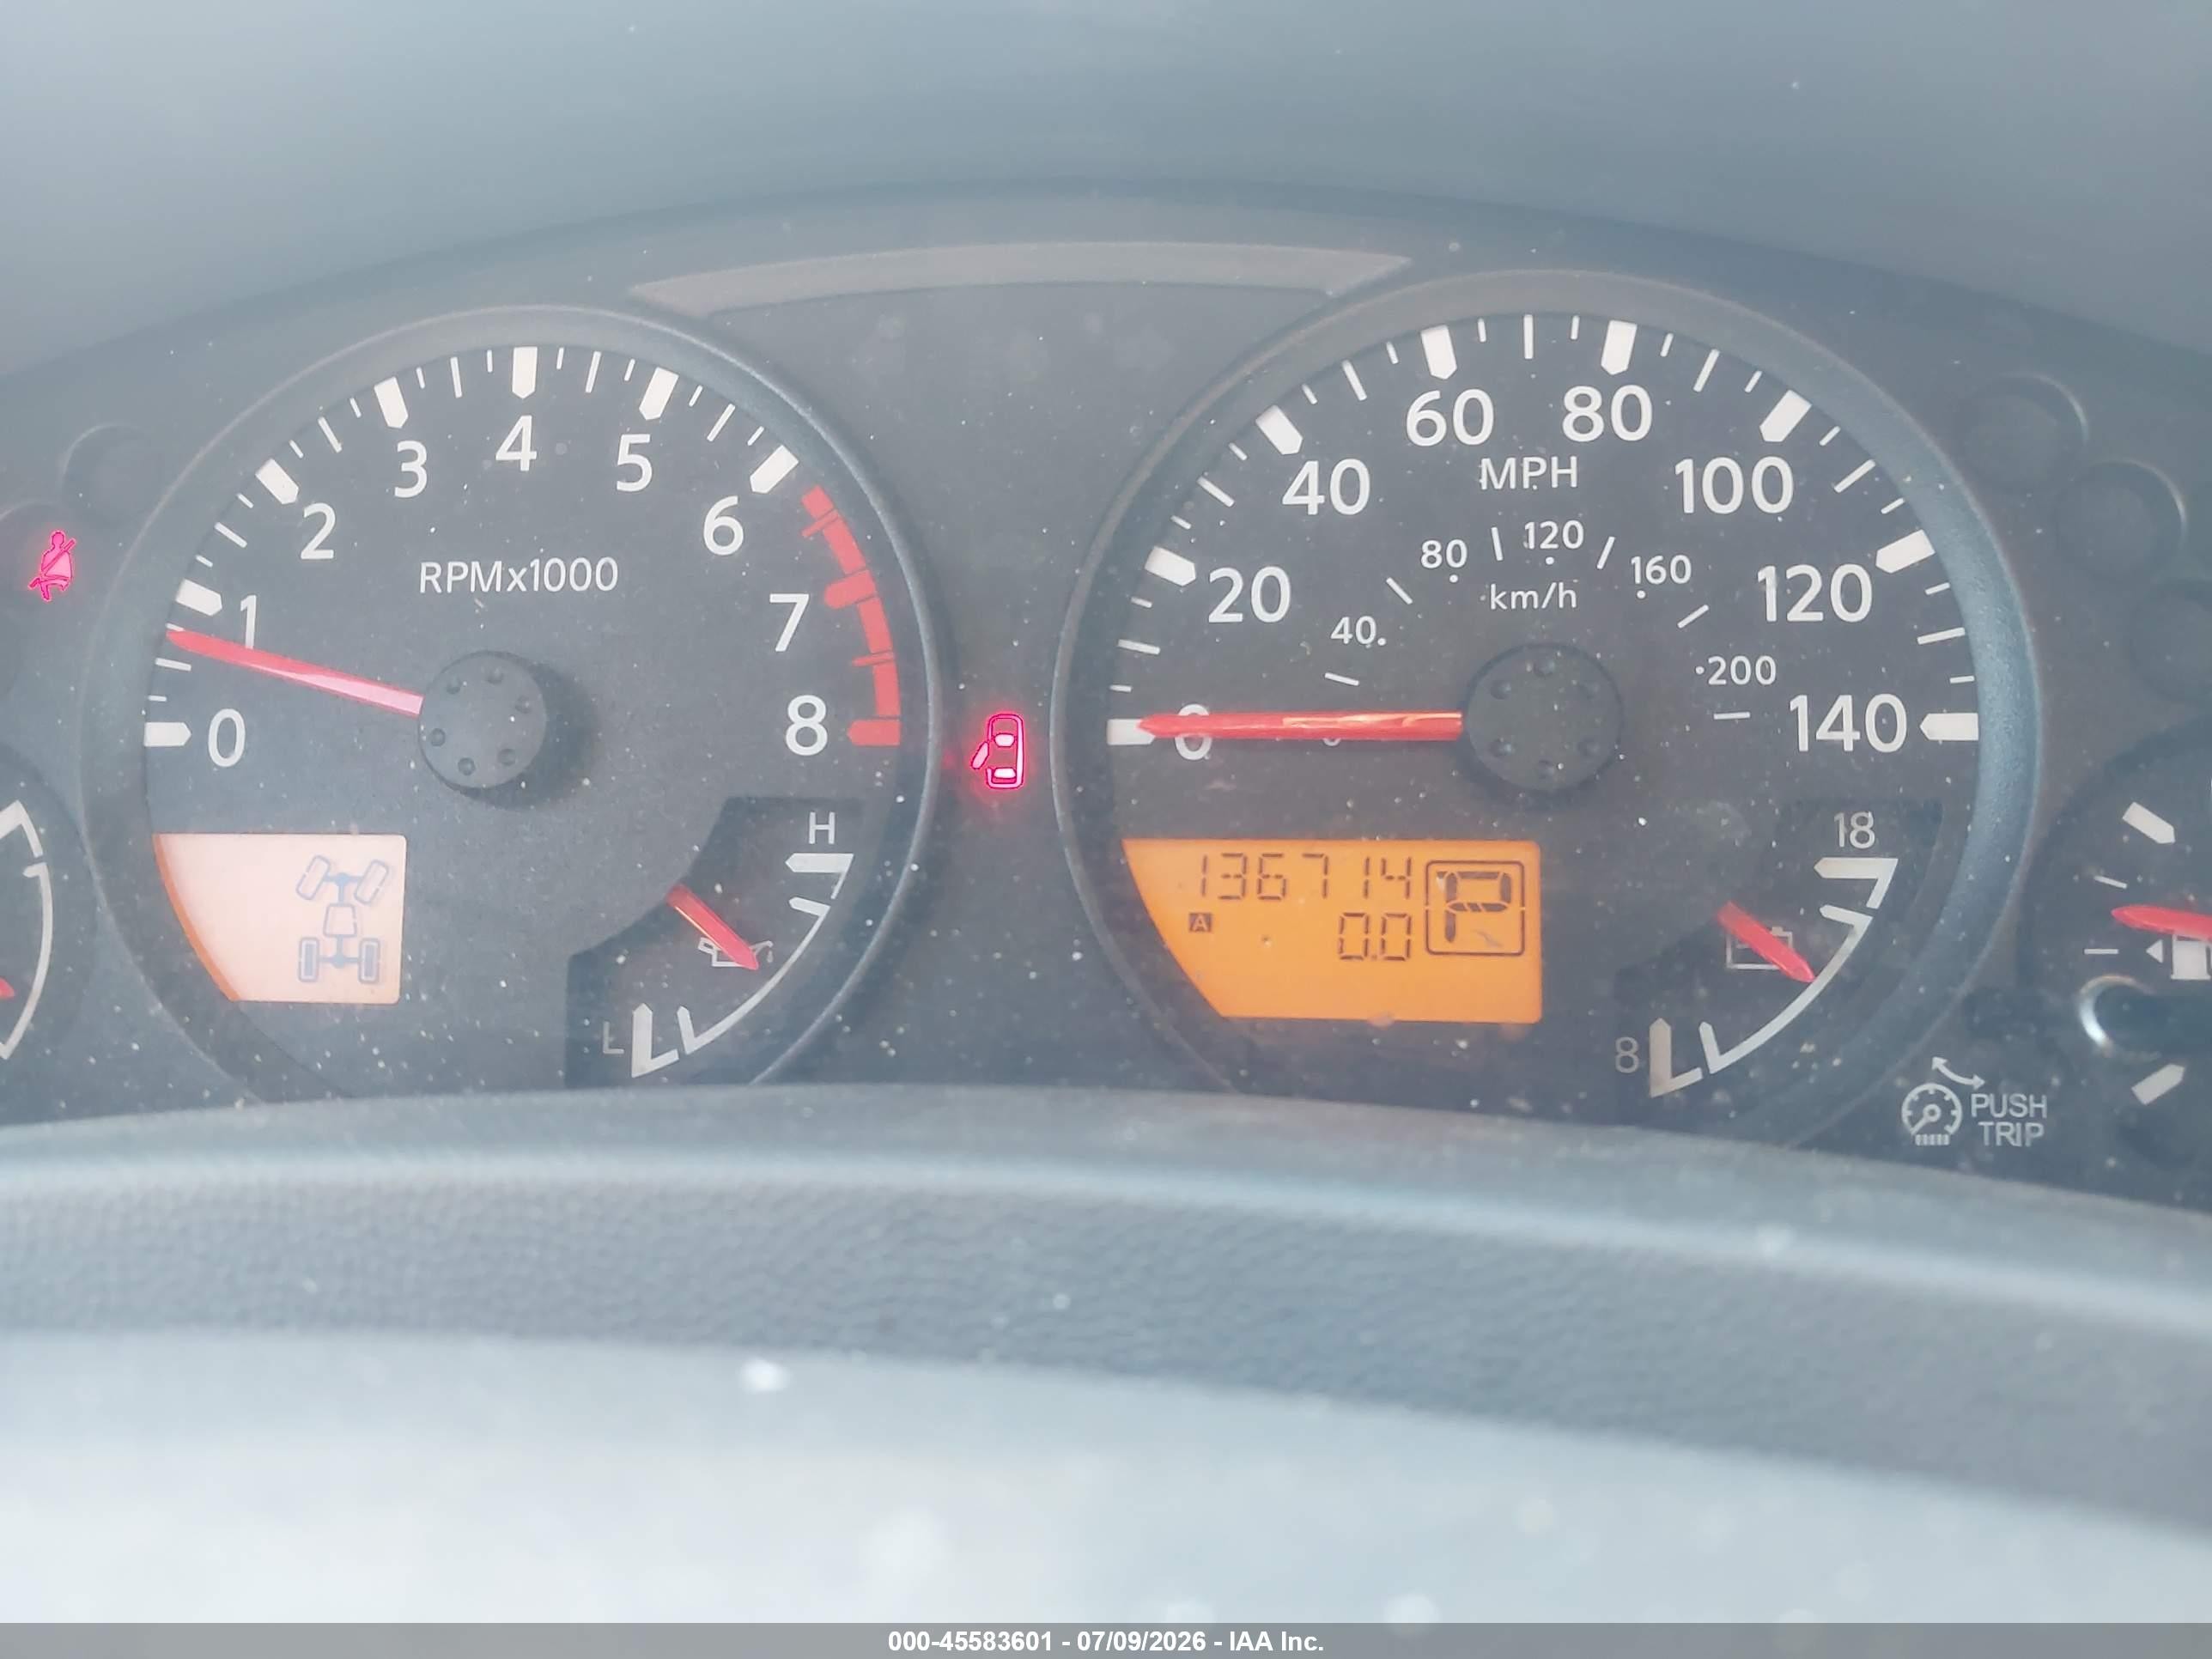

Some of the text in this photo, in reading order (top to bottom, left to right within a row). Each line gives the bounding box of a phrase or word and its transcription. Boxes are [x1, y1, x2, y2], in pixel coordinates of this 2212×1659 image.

[1406, 388, 1494, 447] 60
[1561, 384, 1653, 442] 80
[394, 441, 428, 498] 3
[495, 415, 537, 471] 4
[617, 434, 653, 492] 5
[1282, 458, 1371, 515] 40
[1480, 456, 1578, 490] MPH
[1674, 456, 1794, 514] 100
[300, 503, 337, 560] 2
[702, 495, 744, 556] 6
[1523, 520, 1585, 550] 120
[419, 556, 619, 594] RPMx1000
[1420, 538, 1468, 569] 80
[1630, 555, 1692, 586] 160
[1207, 565, 1291, 623] 20
[1489, 581, 1578, 611] km/h
[1757, 563, 1874, 623] 120
[239, 594, 258, 649] 1
[769, 593, 810, 652] 7
[1330, 616, 1377, 646] 40
[1707, 656, 1778, 685] 200
[208, 708, 246, 768] 0
[785, 695, 829, 757] 8
[1790, 693, 1908, 753] 140
[808, 811, 836, 845] H
[1834, 811, 1876, 849] 18
[1200, 853, 1413, 902] 136714
[1437, 871, 1512, 944] P
[1339, 912, 1413, 962] 0.0
[603, 1022, 625, 1054] L
[1614, 1037, 1640, 1073] 8
[1970, 1093, 2048, 1121] PUSH
[1978, 1121, 2045, 1148] TRIP
